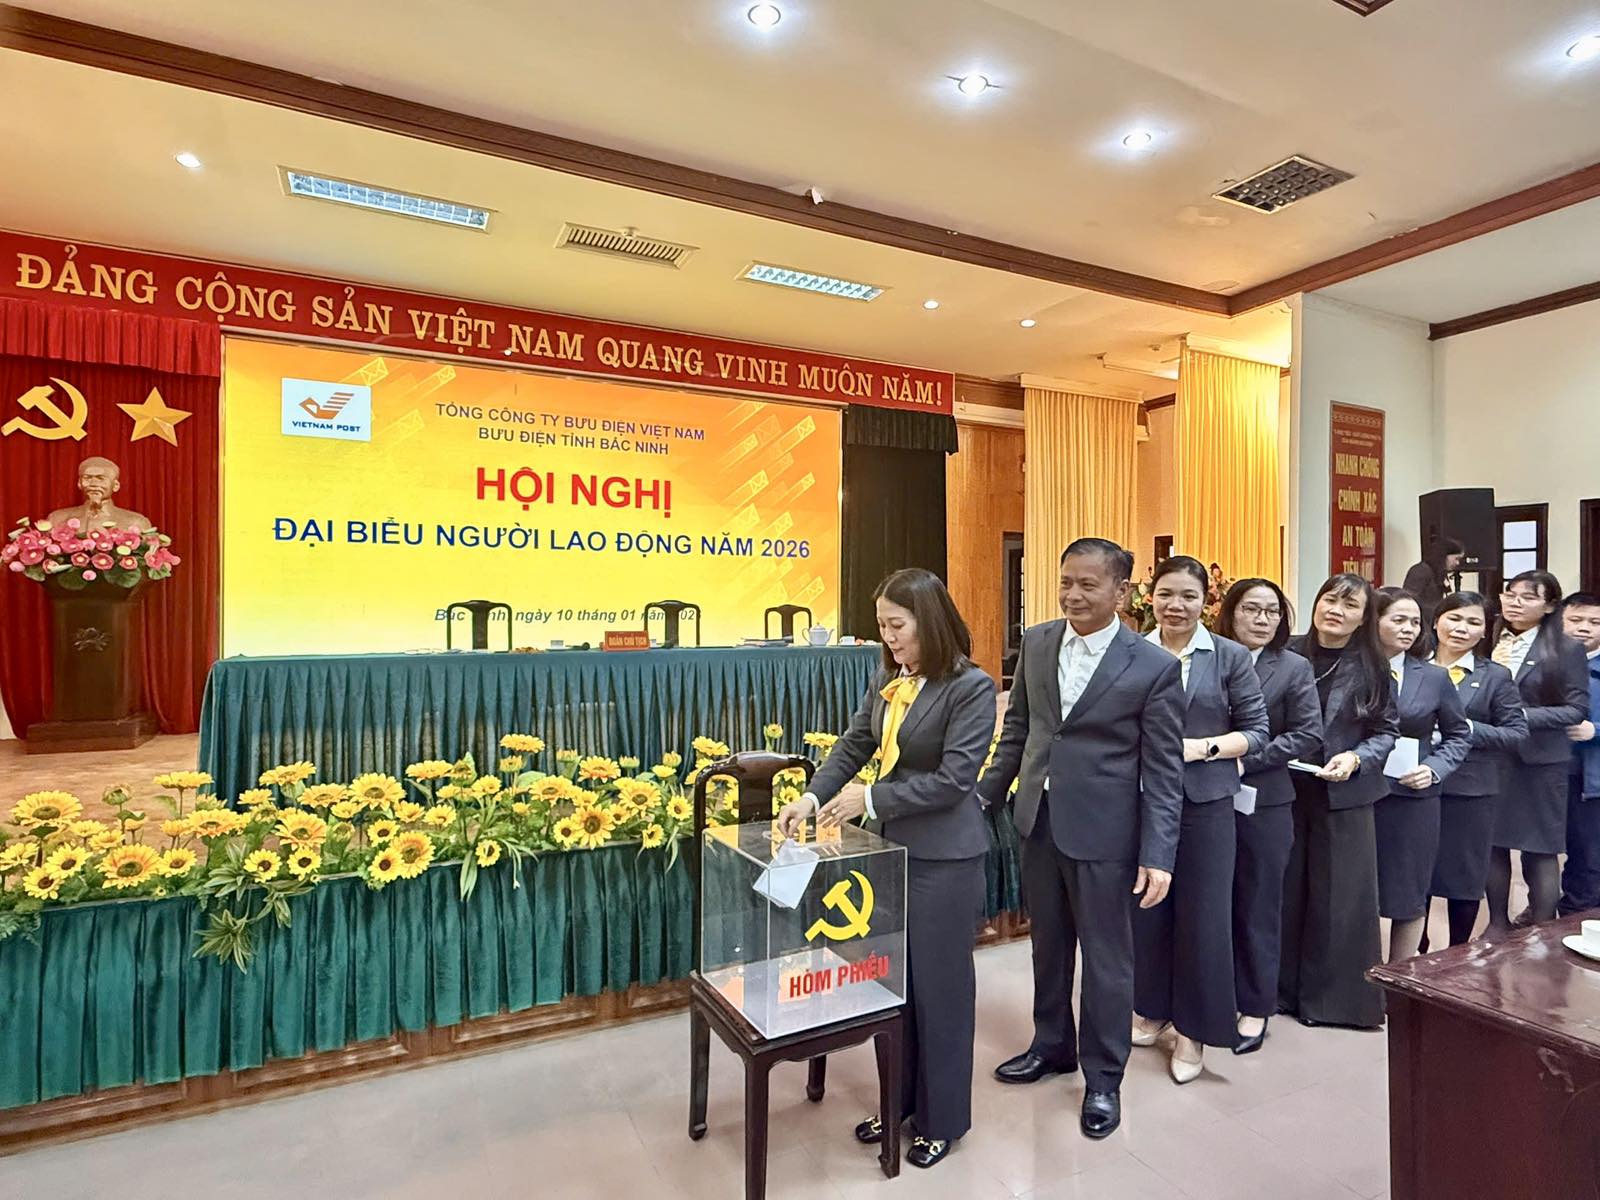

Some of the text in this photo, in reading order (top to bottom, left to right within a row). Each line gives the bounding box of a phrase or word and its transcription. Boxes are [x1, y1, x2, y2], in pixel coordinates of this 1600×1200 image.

[16, 245, 943, 407] ĐẢNG CỘNG SẢN VIỆT NAM QUANG VINH MUÔN NĂM!
[292, 420, 361, 433] VIETNAM POST
[488, 406, 536, 425] CÔNG
[540, 413, 560, 426] TY
[564, 416, 597, 431] BƯU
[602, 419, 636, 437] ĐIỆN
[640, 423, 671, 440] VIỆT
[674, 427, 705, 440] NAM
[479, 427, 515, 442] BƯU
[519, 430, 556, 448] ĐIỆN
[635, 441, 669, 455] NINH
[476, 466, 672, 518] HỘI NGHỊ
[272, 516, 811, 559] ĐẠI BIỂU NGƯỜI LAO ĐỘNG NĂM 2026
[515, 609, 551, 624] ngày
[557, 609, 574, 621] 10
[577, 608, 617, 624] tháng
[621, 609, 636, 621] 01
[789, 968, 832, 998] HÒM
